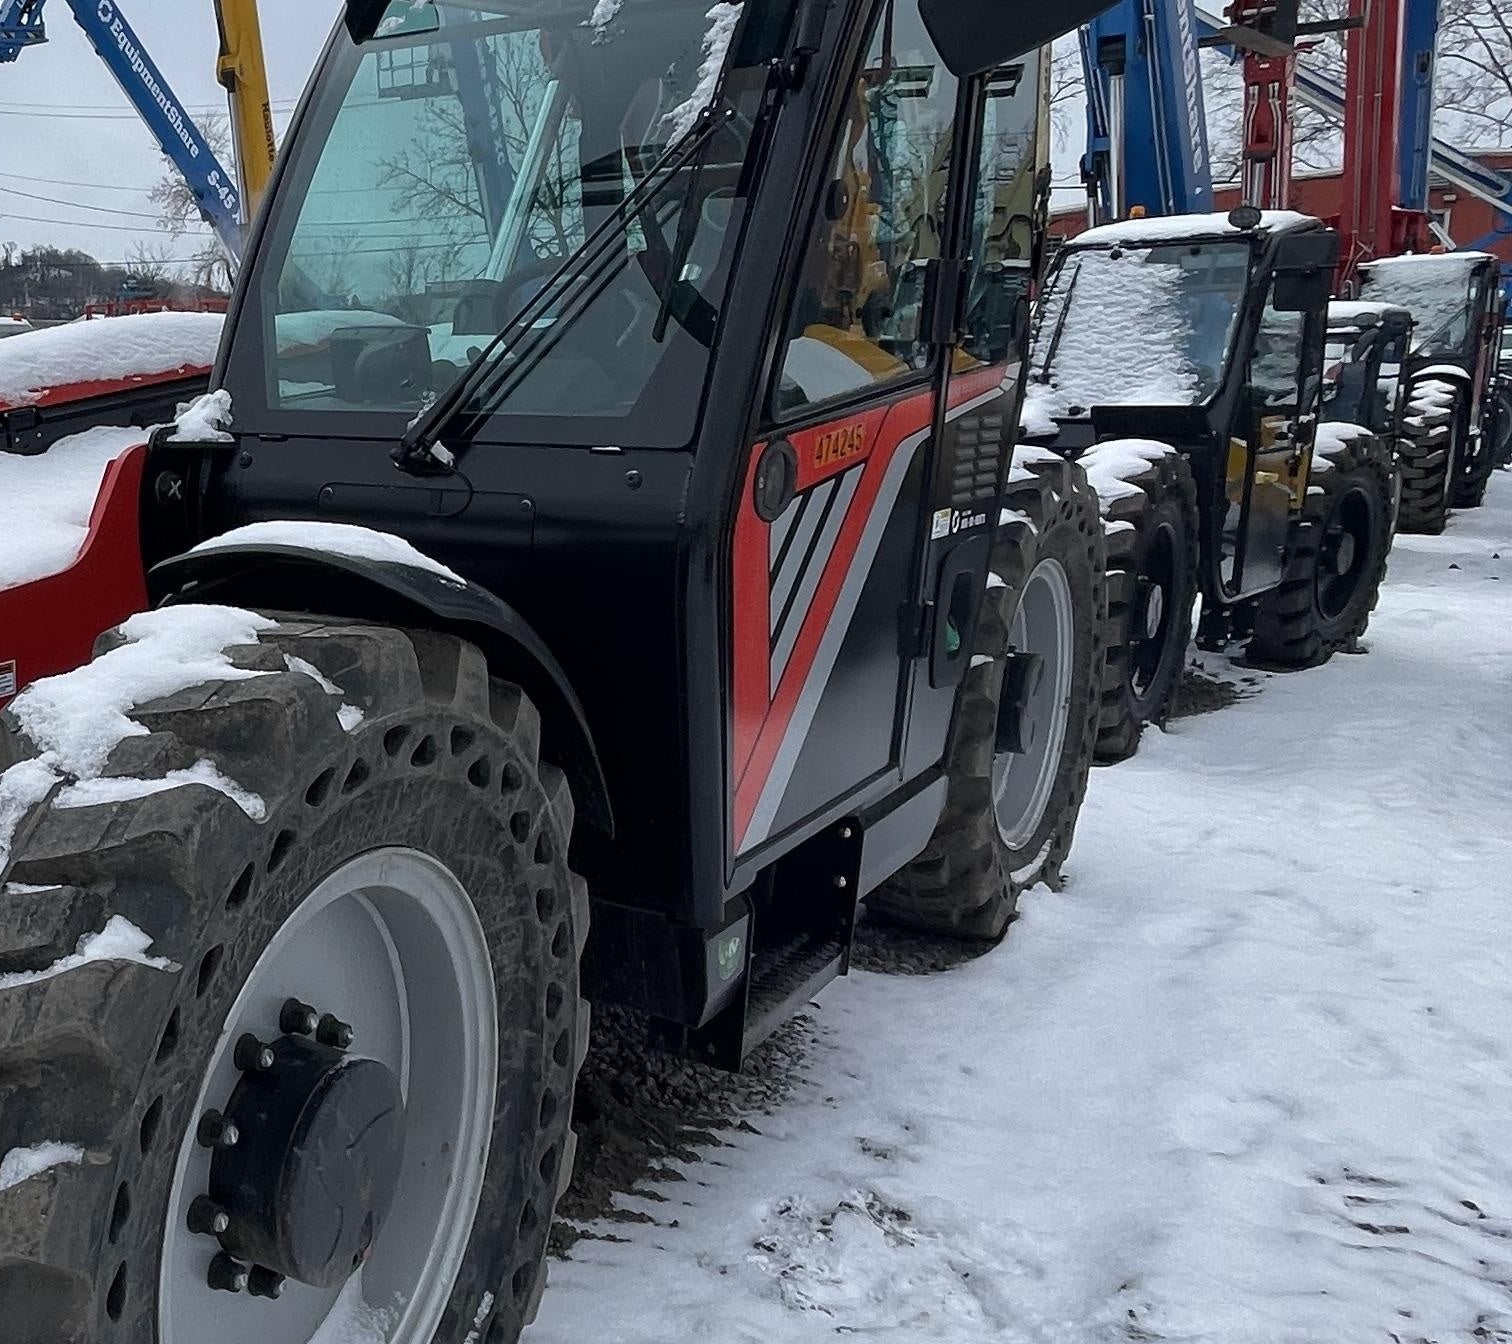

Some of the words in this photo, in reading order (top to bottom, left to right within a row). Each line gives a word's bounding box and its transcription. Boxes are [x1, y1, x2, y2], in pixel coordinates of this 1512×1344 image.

[109, 16, 200, 158] EquipmentShare
[207, 170, 237, 209] S-45
[815, 424, 863, 465] 474245
